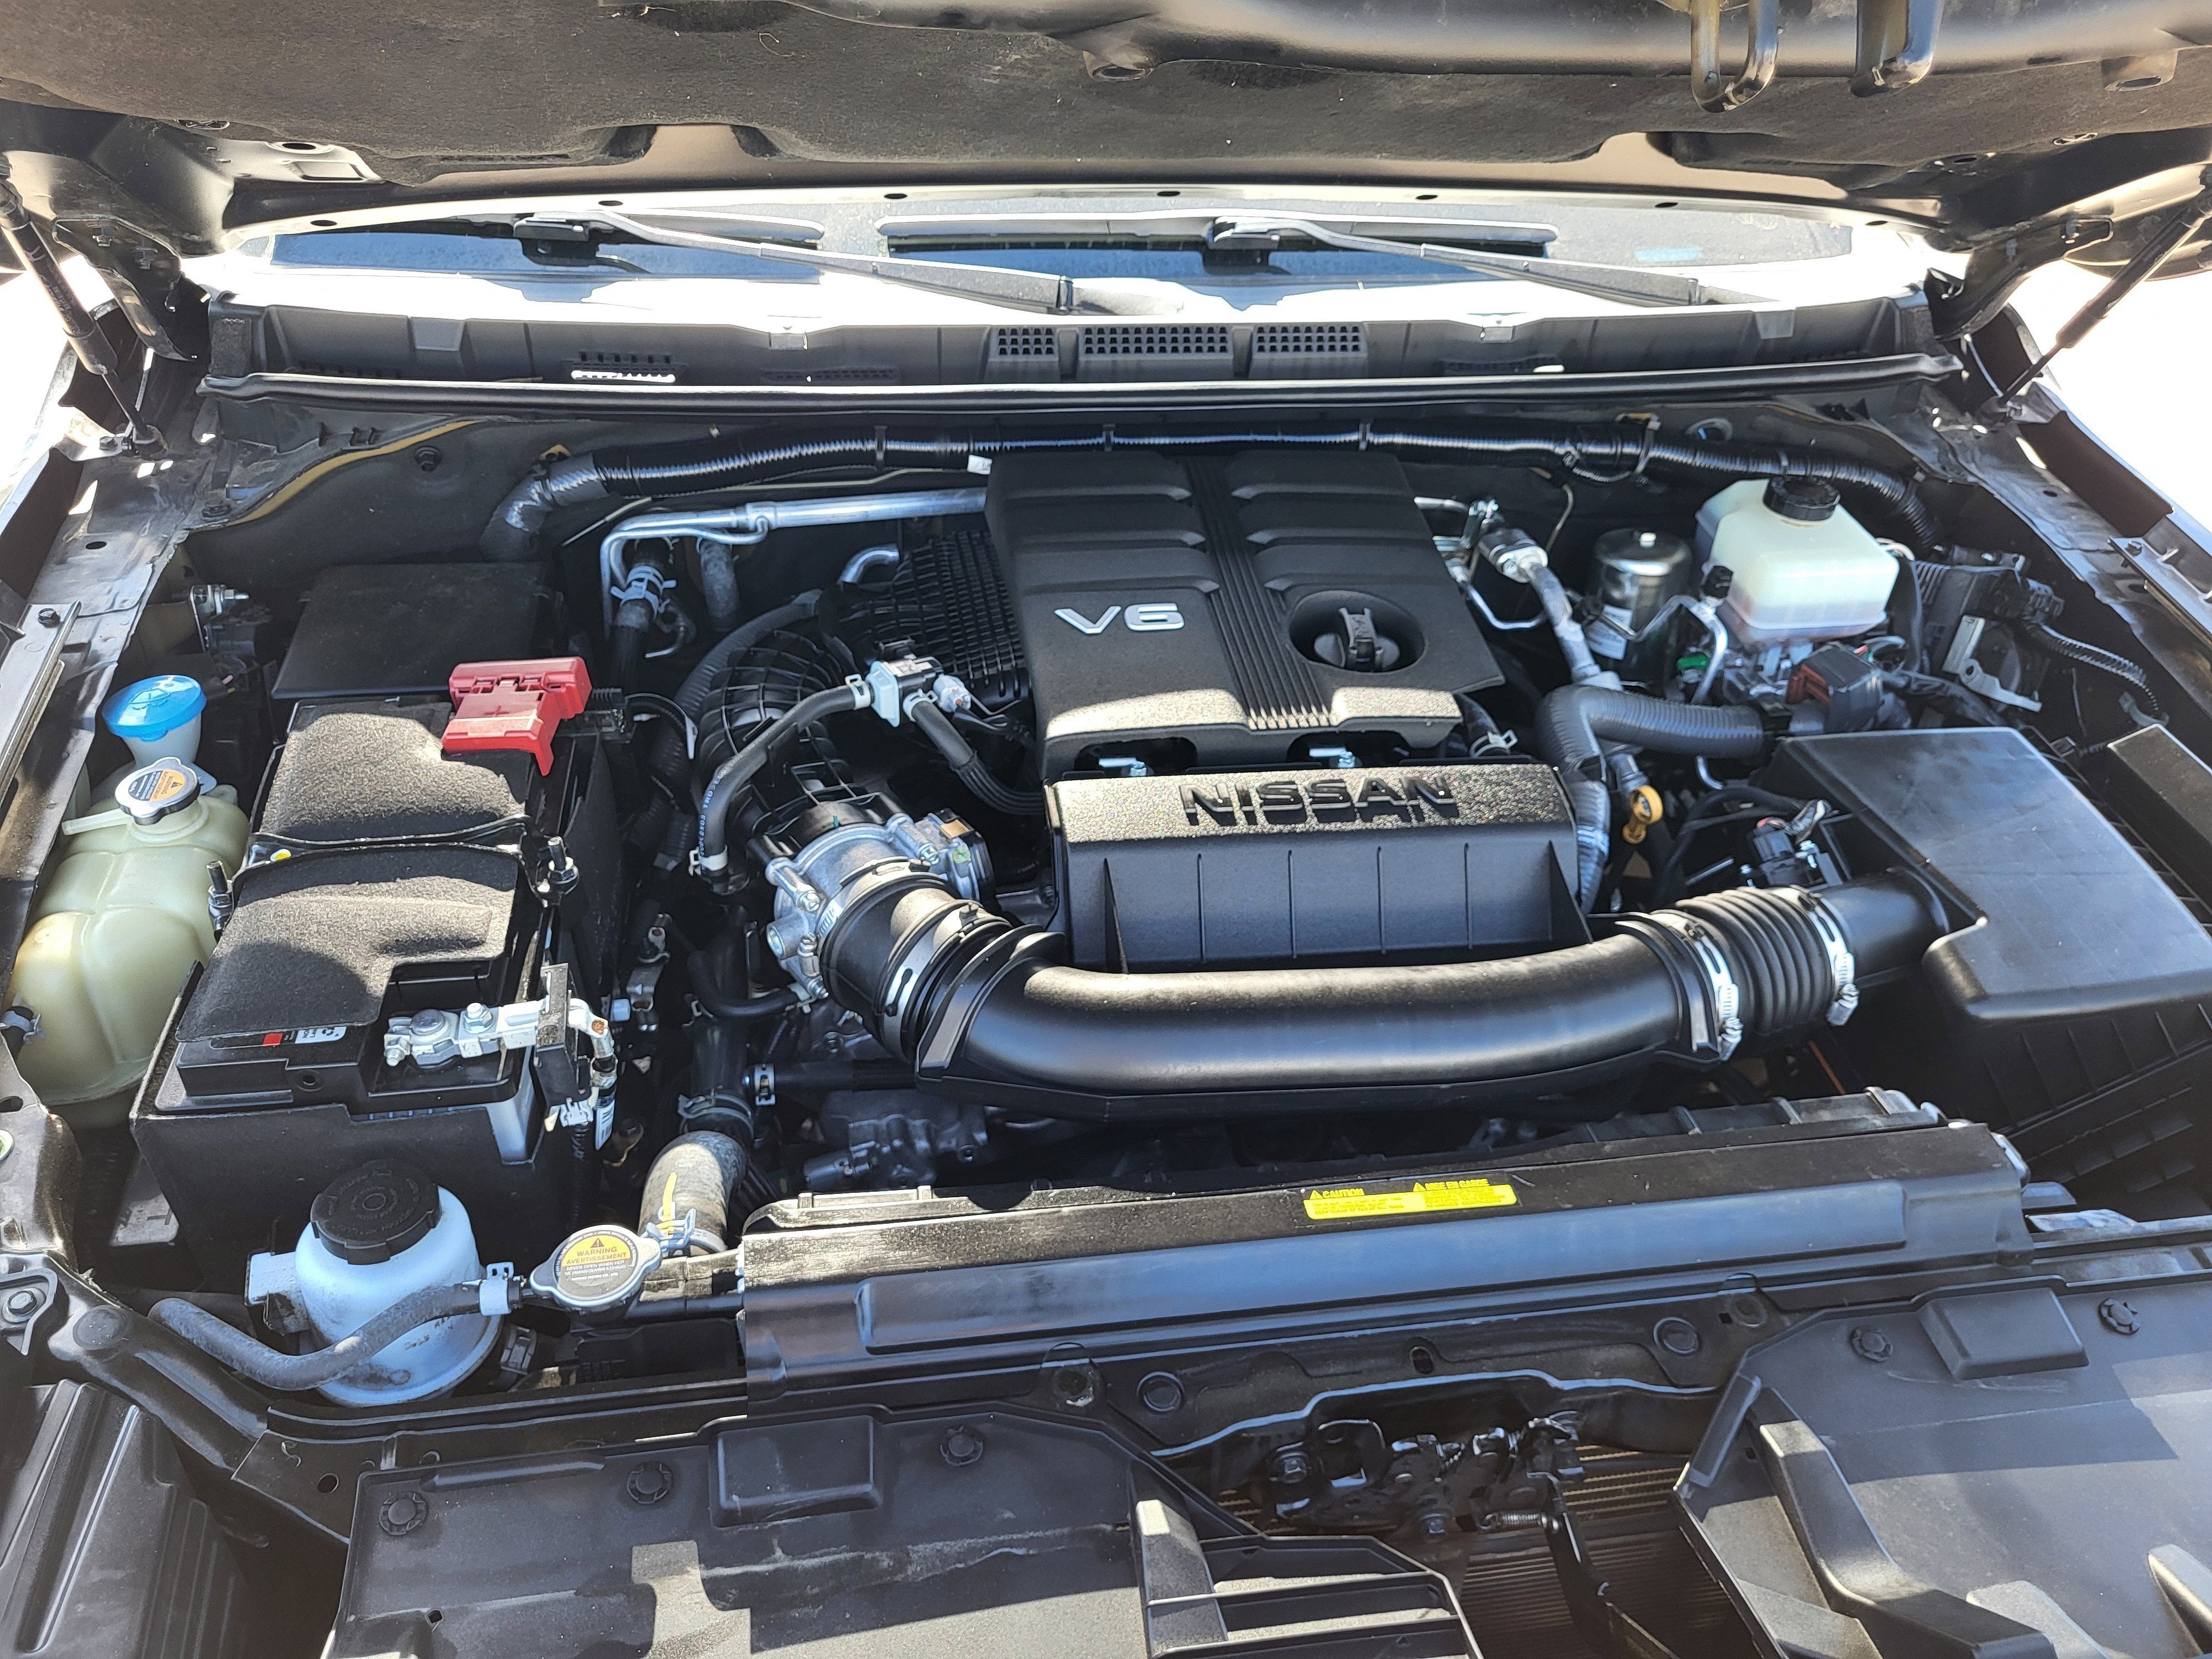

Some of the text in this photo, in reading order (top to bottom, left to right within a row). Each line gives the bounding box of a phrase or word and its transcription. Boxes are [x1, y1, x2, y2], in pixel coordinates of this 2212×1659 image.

[1053, 602, 1185, 634] V6
[1180, 776, 1460, 826] NISSAN
[1322, 1188, 1365, 1199] CAUTION
[577, 1246, 617, 1257] WARNING
[566, 1252, 627, 1265] AVERTISSEMENT
